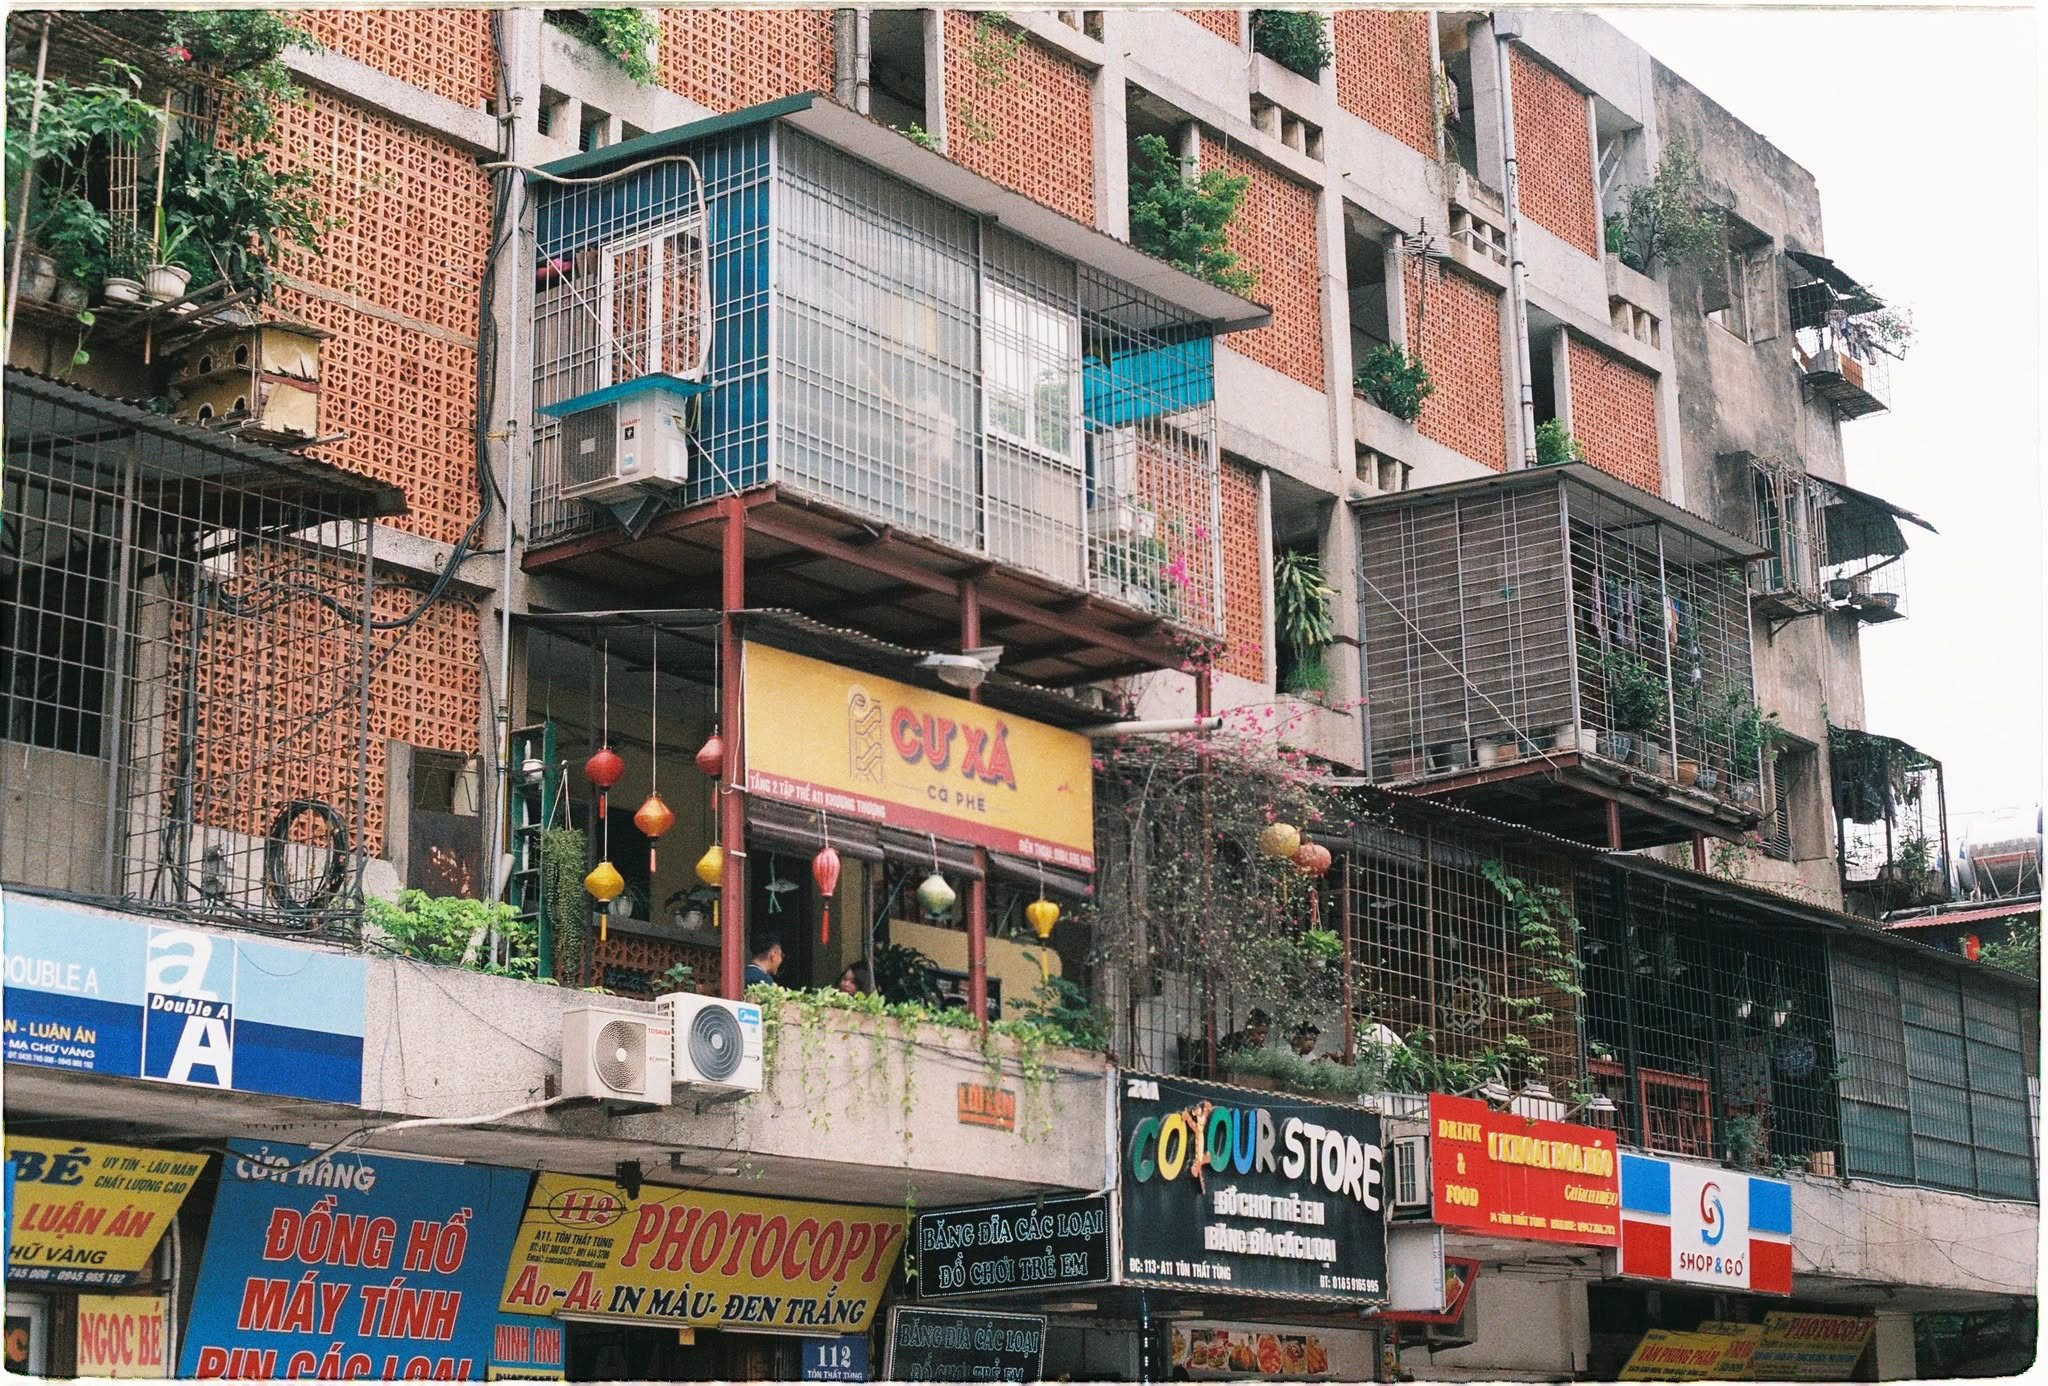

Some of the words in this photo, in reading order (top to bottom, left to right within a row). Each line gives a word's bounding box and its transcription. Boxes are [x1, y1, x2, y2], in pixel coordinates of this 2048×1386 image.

[83, 967, 98, 994] A
[151, 995, 212, 1016] Double
[216, 1005, 229, 1020] A
[29, 1022, 71, 1042] LUẬN
[73, 1025, 97, 1044] ÁN
[1438, 1119, 1482, 1143] DRINK
[102, 1156, 119, 1170] UY
[1280, 1116, 1384, 1212] STORE
[1456, 1152, 1466, 1175] &
[163, 1181, 188, 1194] CAO
[1446, 1184, 1479, 1208] FOOD
[19, 1200, 107, 1240] LUẬN
[104, 1204, 155, 1238] ÁN
[557, 1192, 615, 1226] 112
[263, 1194, 397, 1270] ĐỒNG
[403, 1207, 473, 1275] HỒ
[1057, 1209, 1103, 1241] LOẠI
[45, 1245, 108, 1265] VÀNG
[620, 1203, 903, 1283] PHOTOCOPY
[1060, 1252, 1088, 1277] EM
[1176, 1261, 1190, 1277] TÔN
[1192, 1261, 1210, 1278] THẤT
[1213, 1263, 1231, 1280] TÙNG
[237, 1271, 351, 1335] MÁY
[358, 1276, 463, 1341] TÍNH
[608, 1285, 646, 1314] IN
[721, 1293, 781, 1325] ĐEN
[784, 1284, 866, 1326] TRẮNG
[79, 1312, 134, 1377] NGỌC
[138, 1301, 162, 1366] BÉ
[494, 1324, 530, 1363] MINH
[533, 1326, 561, 1365] ANH
[817, 1344, 851, 1368] 112
[808, 1368, 822, 1379] TÔN
[824, 1368, 842, 1379] THẤT
